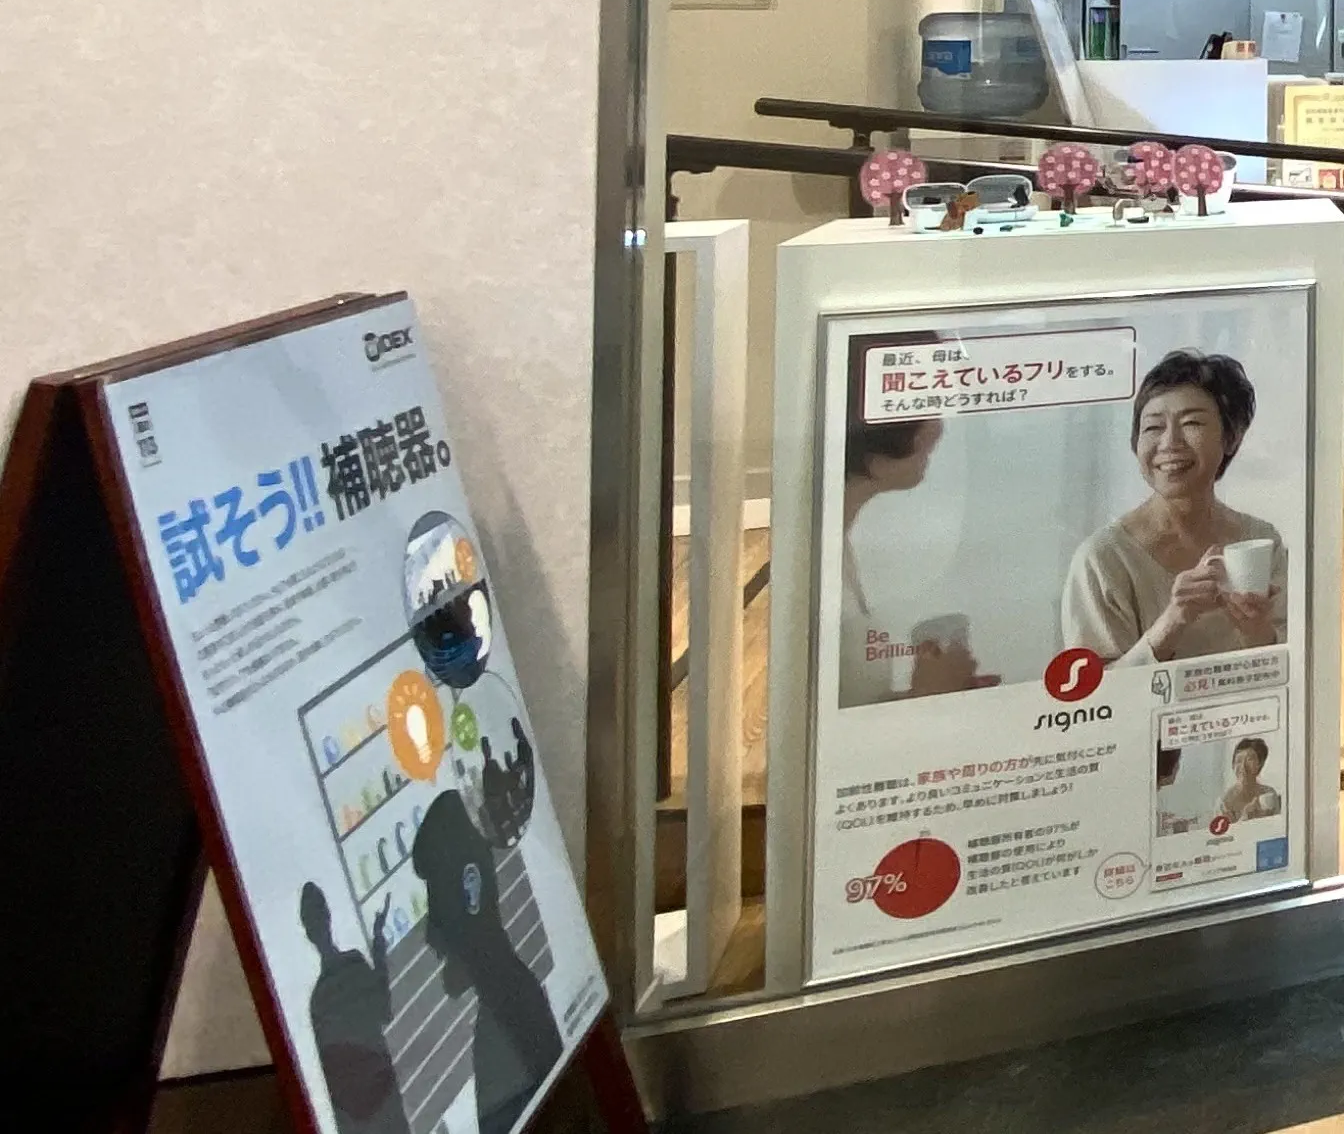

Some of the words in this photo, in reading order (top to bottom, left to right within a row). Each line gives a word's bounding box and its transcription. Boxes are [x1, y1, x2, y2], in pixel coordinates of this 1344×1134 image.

[881, 359, 1115, 394] 聞こえているフリをする。
[866, 629, 890, 644] Be
[866, 643, 928, 662] Brillia
[1033, 703, 1113, 733] signia
[844, 873, 908, 905] 97%
